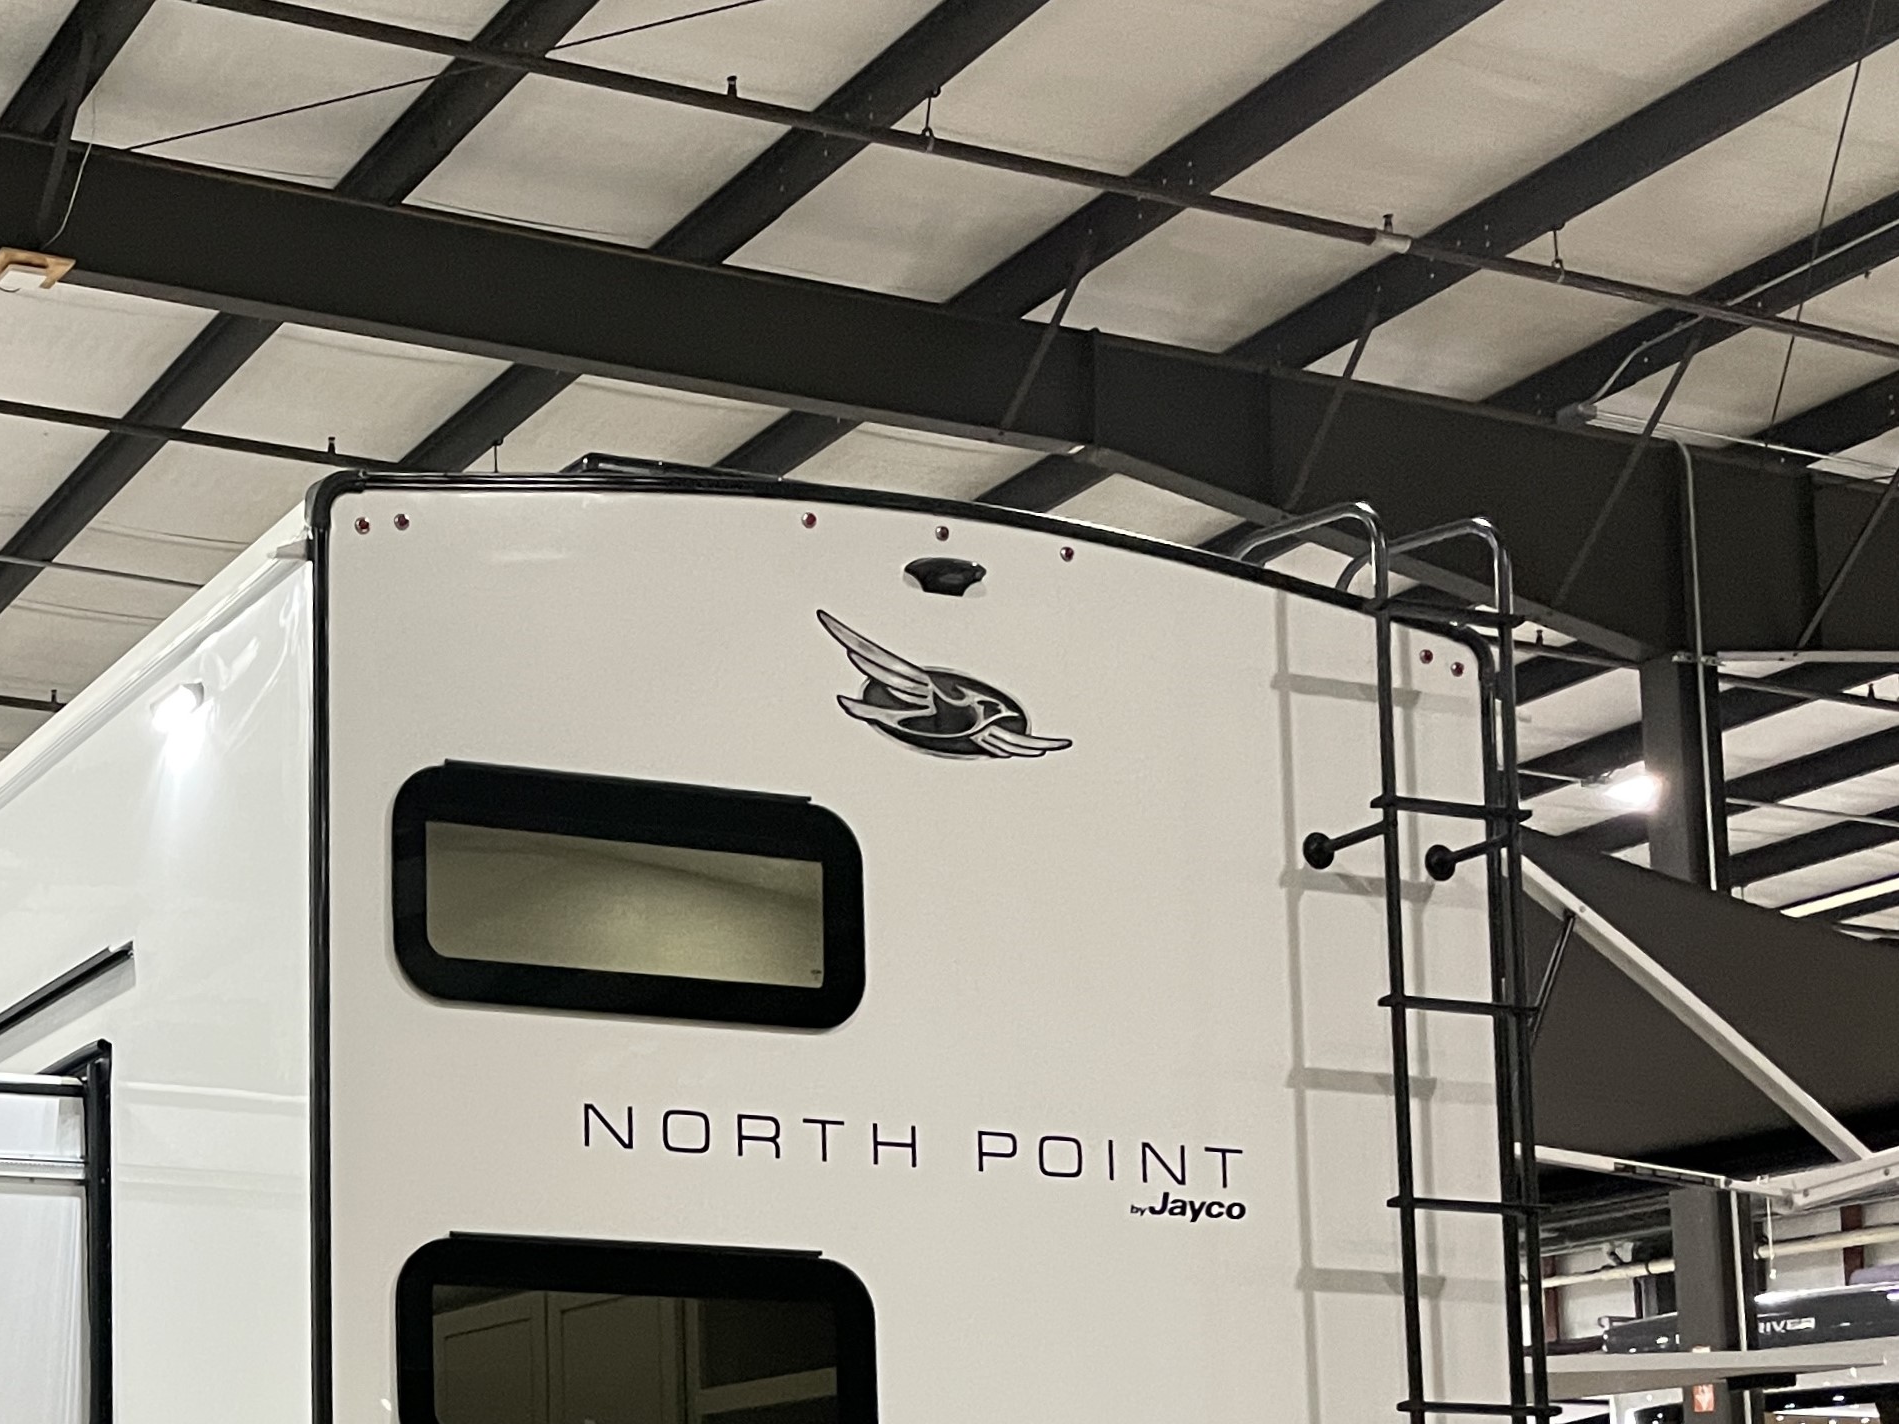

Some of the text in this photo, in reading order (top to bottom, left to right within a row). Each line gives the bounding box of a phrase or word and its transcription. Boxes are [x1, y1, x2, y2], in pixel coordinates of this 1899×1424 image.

[583, 1103, 1244, 1189] NORTH POINT
[1130, 1192, 1246, 1223] by Jayco
